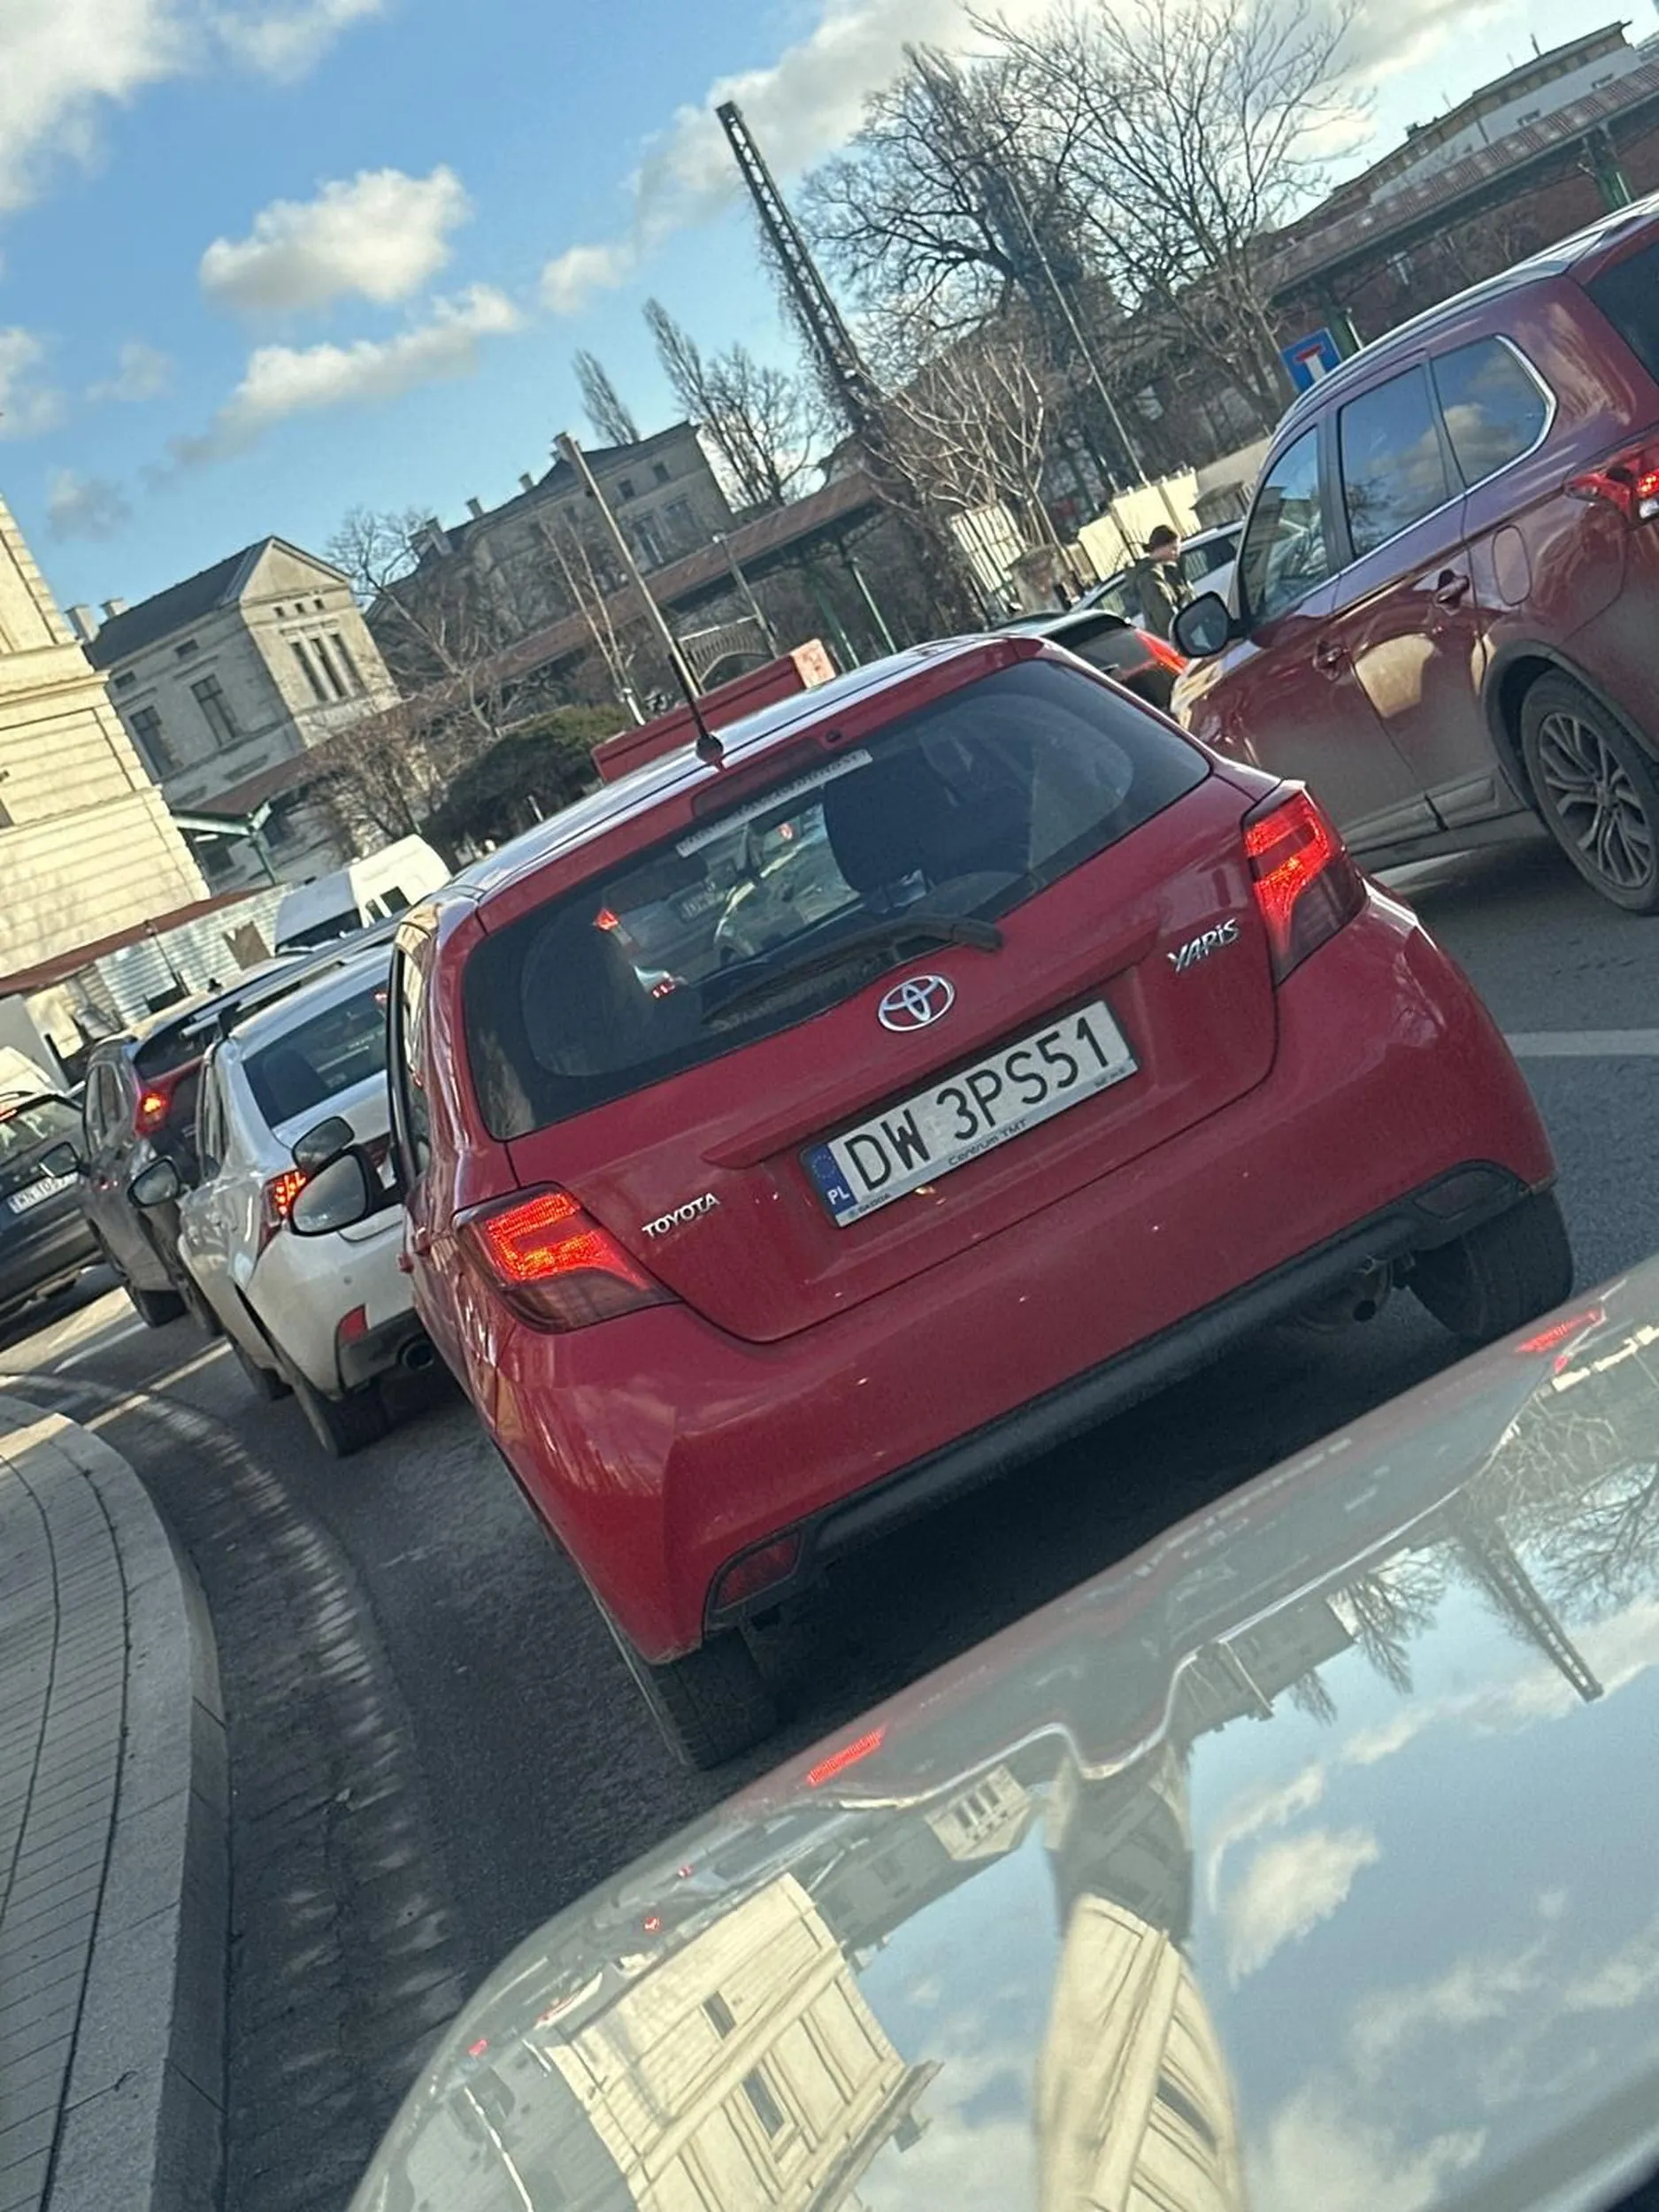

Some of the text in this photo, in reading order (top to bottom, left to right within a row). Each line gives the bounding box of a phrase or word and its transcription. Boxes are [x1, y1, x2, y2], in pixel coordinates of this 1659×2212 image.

[843, 1017, 1110, 1192] DW 3PS51
[641, 1192, 721, 1238] TOYOTA
[826, 1186, 849, 1205] PL
